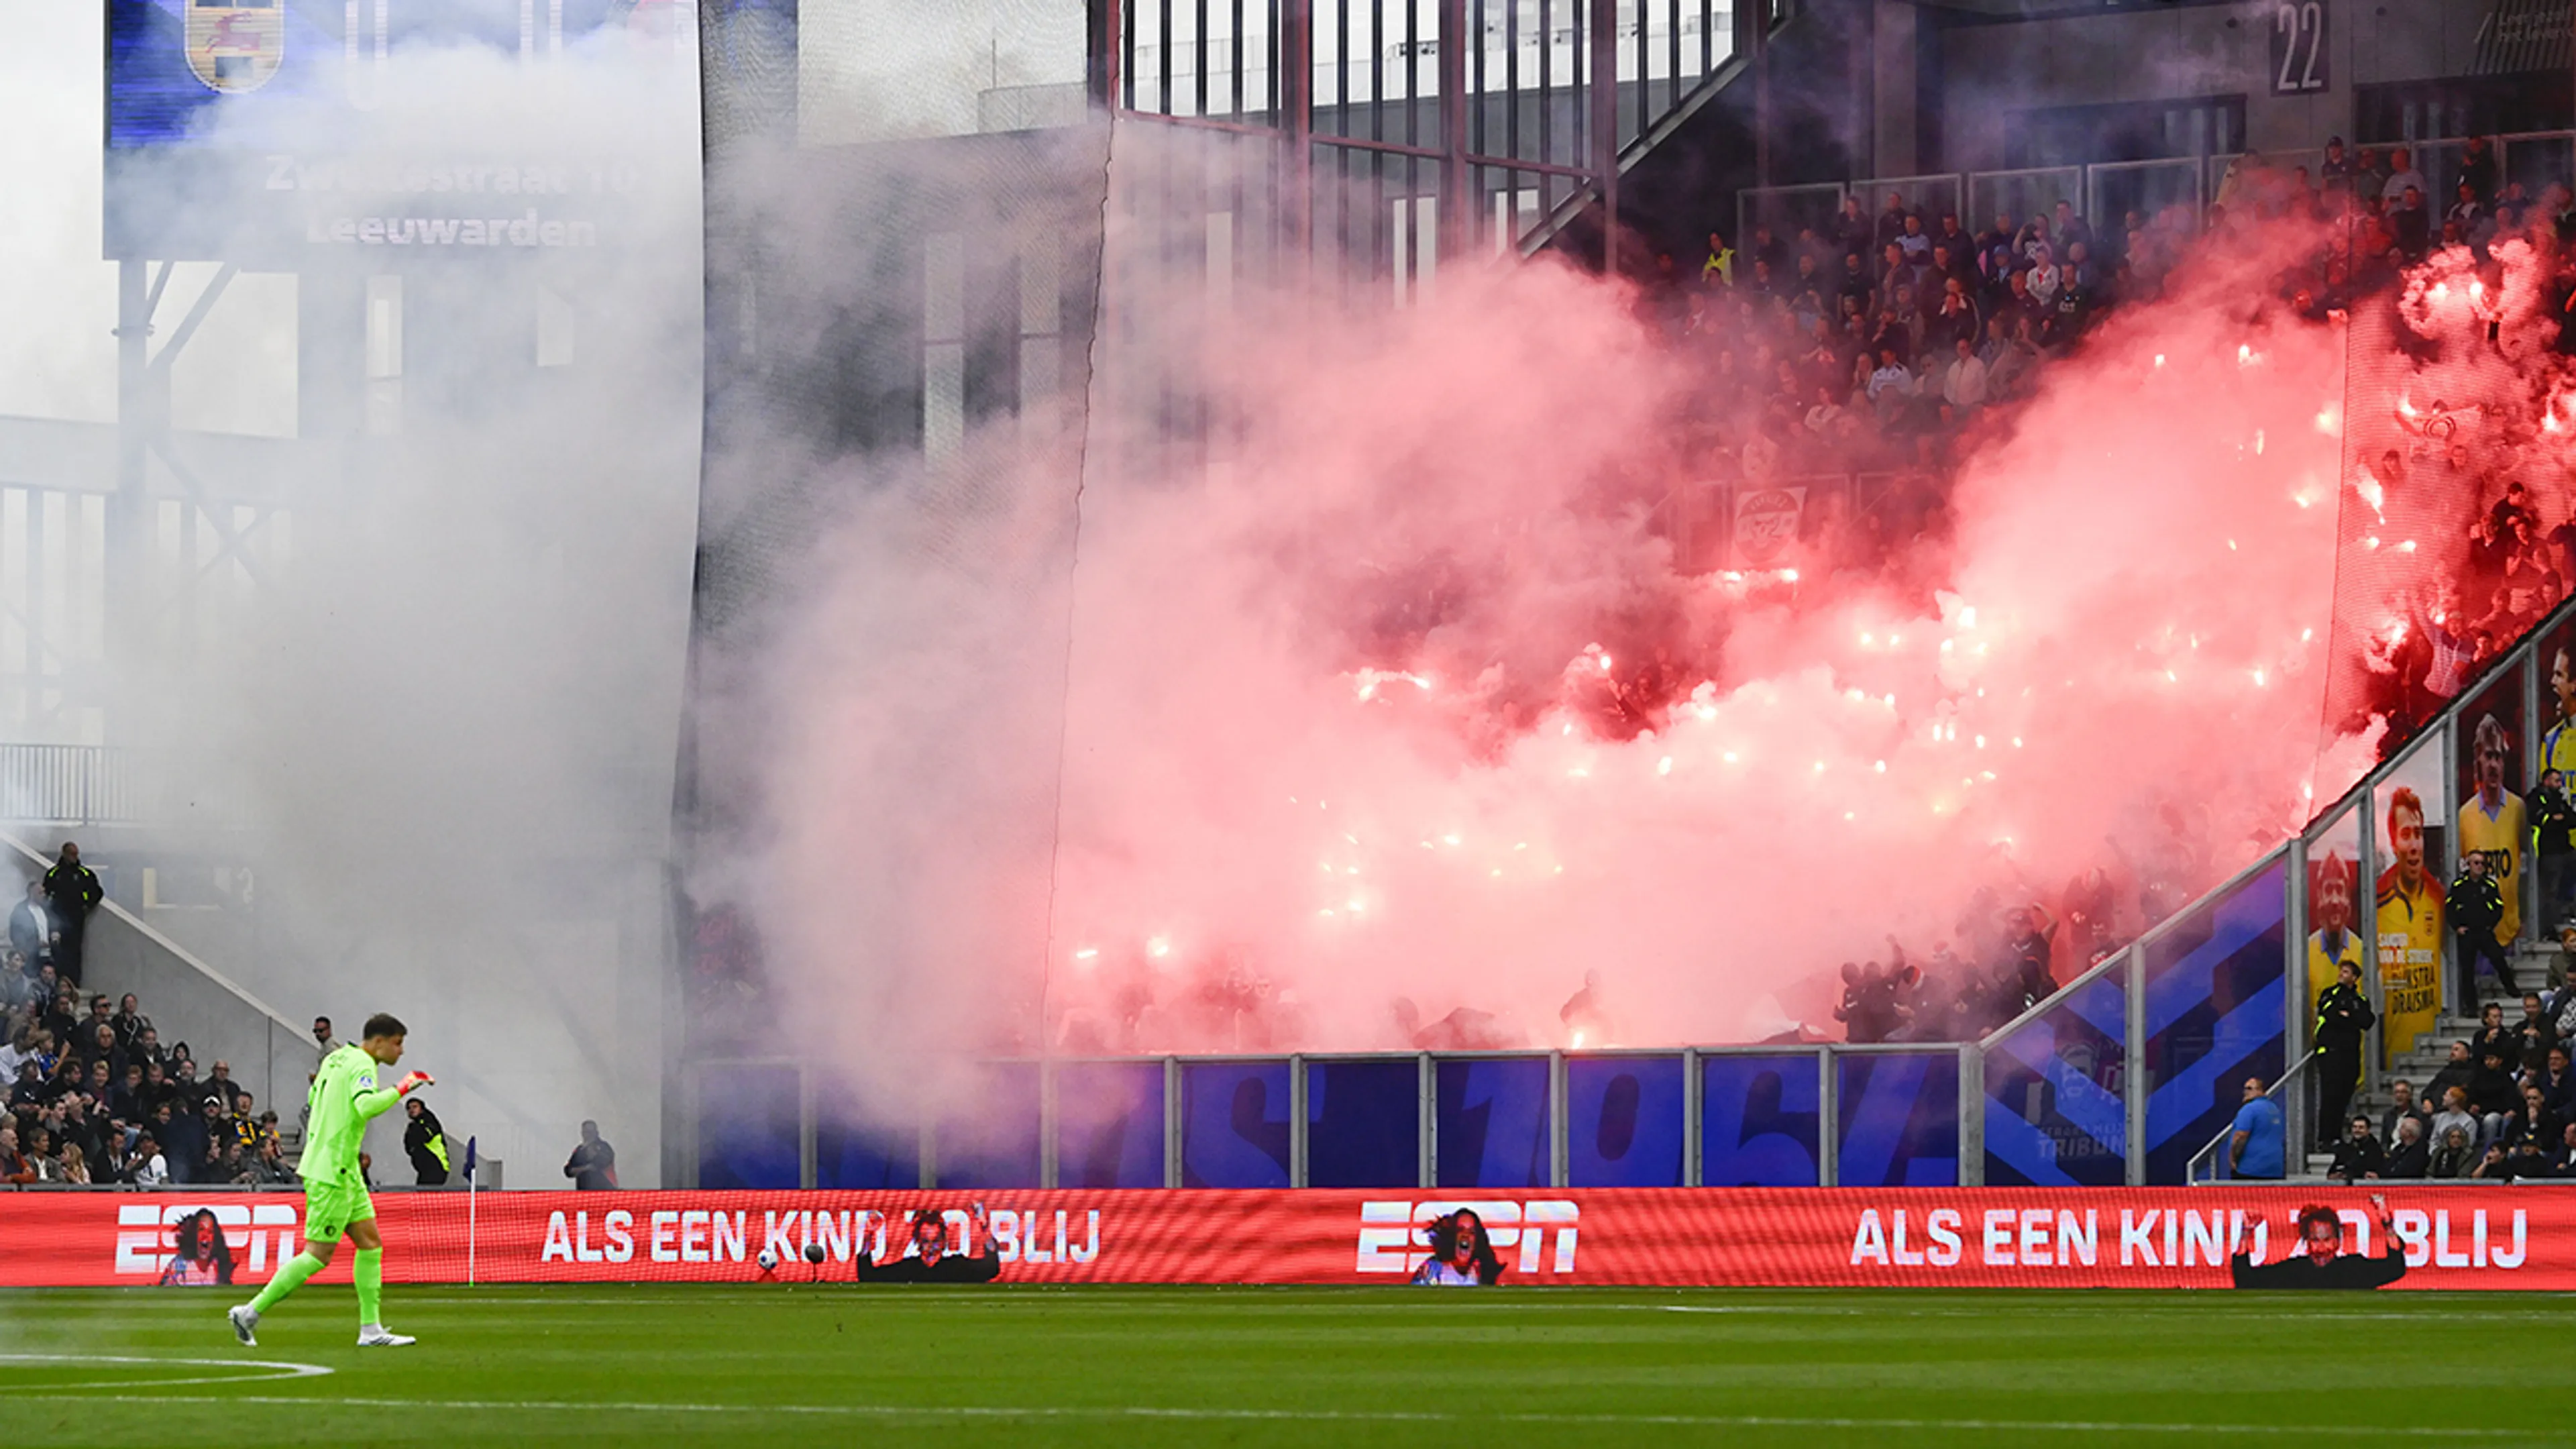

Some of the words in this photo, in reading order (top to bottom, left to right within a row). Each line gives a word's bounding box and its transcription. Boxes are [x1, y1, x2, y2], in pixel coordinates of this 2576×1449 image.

[2277, 2, 2322, 90] 22
[307, 207, 596, 247] Leeuwarden
[2037, 1134, 2126, 1158] TRIBUN
[541, 1210, 634, 1263] ALS
[651, 1210, 746, 1263] EEN
[765, 1210, 887, 1263] KIND
[989, 1210, 1100, 1263] BLIJ
[1849, 1209, 1962, 1267] ALS
[1983, 1209, 2098, 1266] EEN
[2121, 1209, 2267, 1267] KIND
[2289, 1209, 2370, 1259] O
[2394, 1209, 2527, 1269] BLIJ
